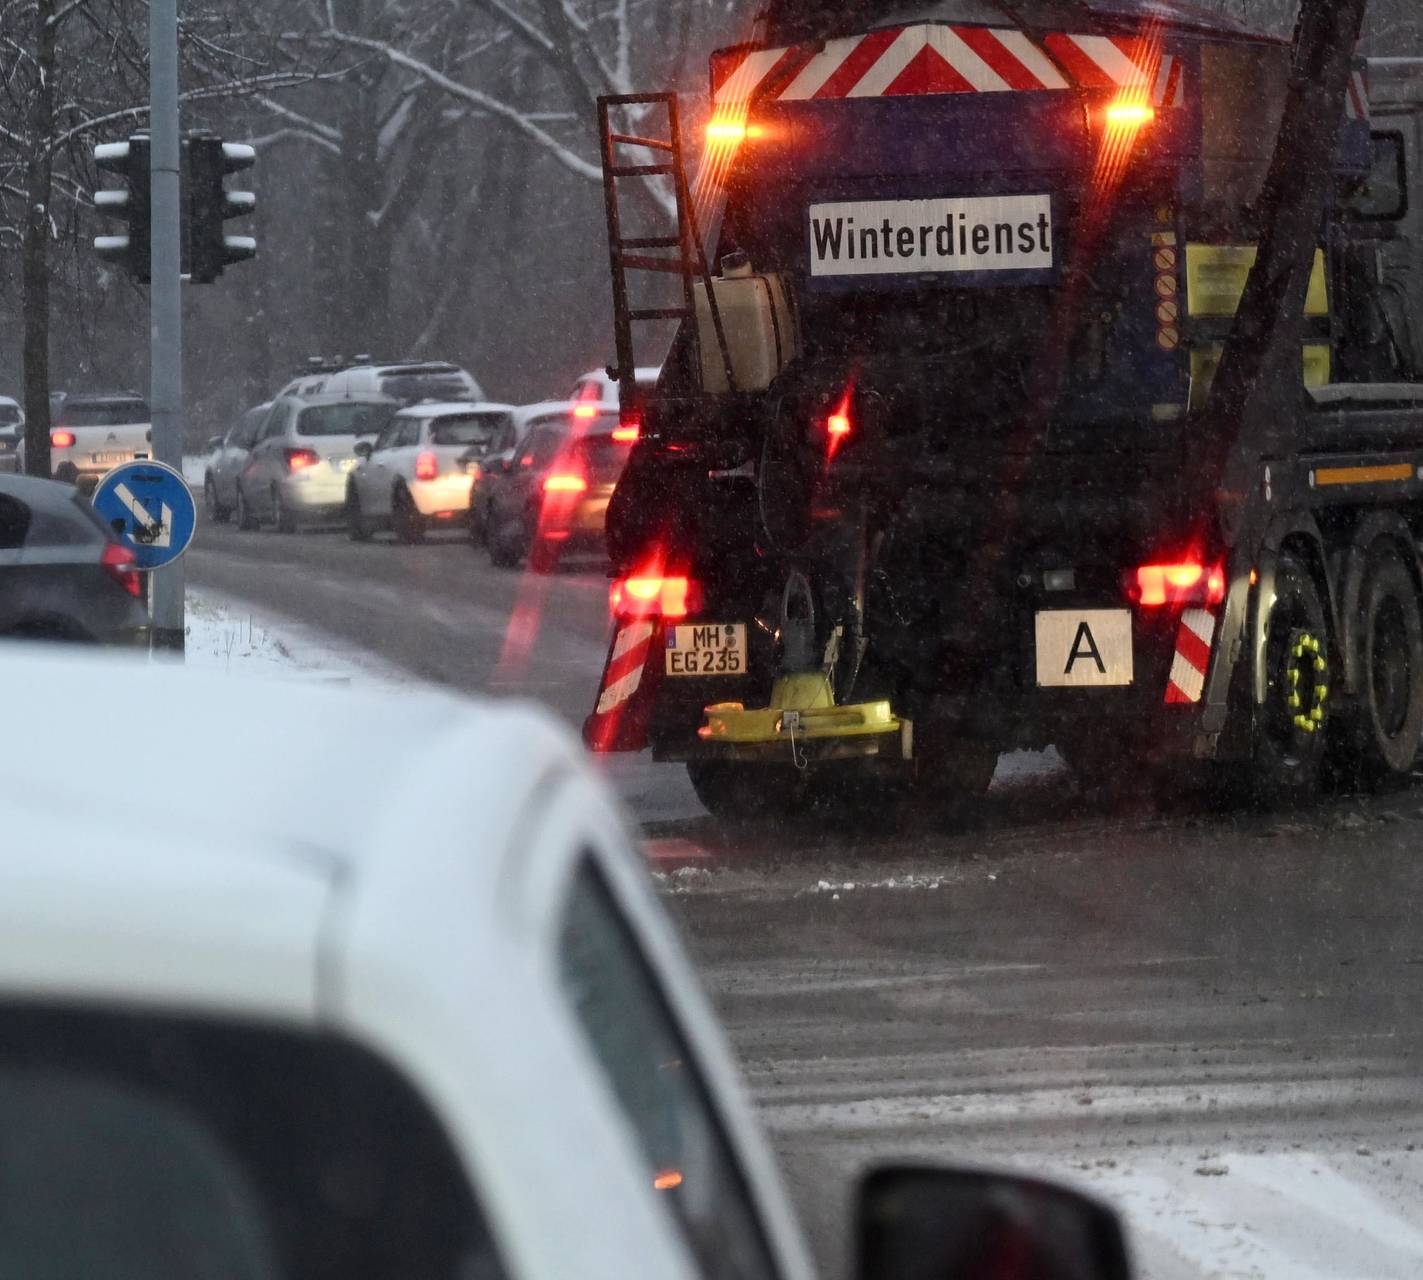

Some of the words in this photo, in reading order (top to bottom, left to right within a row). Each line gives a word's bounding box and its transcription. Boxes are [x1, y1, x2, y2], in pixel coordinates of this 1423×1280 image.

[812, 213, 1050, 260] Winterdienst
[693, 627, 720, 648] MH
[1064, 621, 1106, 673] A
[671, 651, 698, 673] EG
[703, 650, 740, 672] 235
